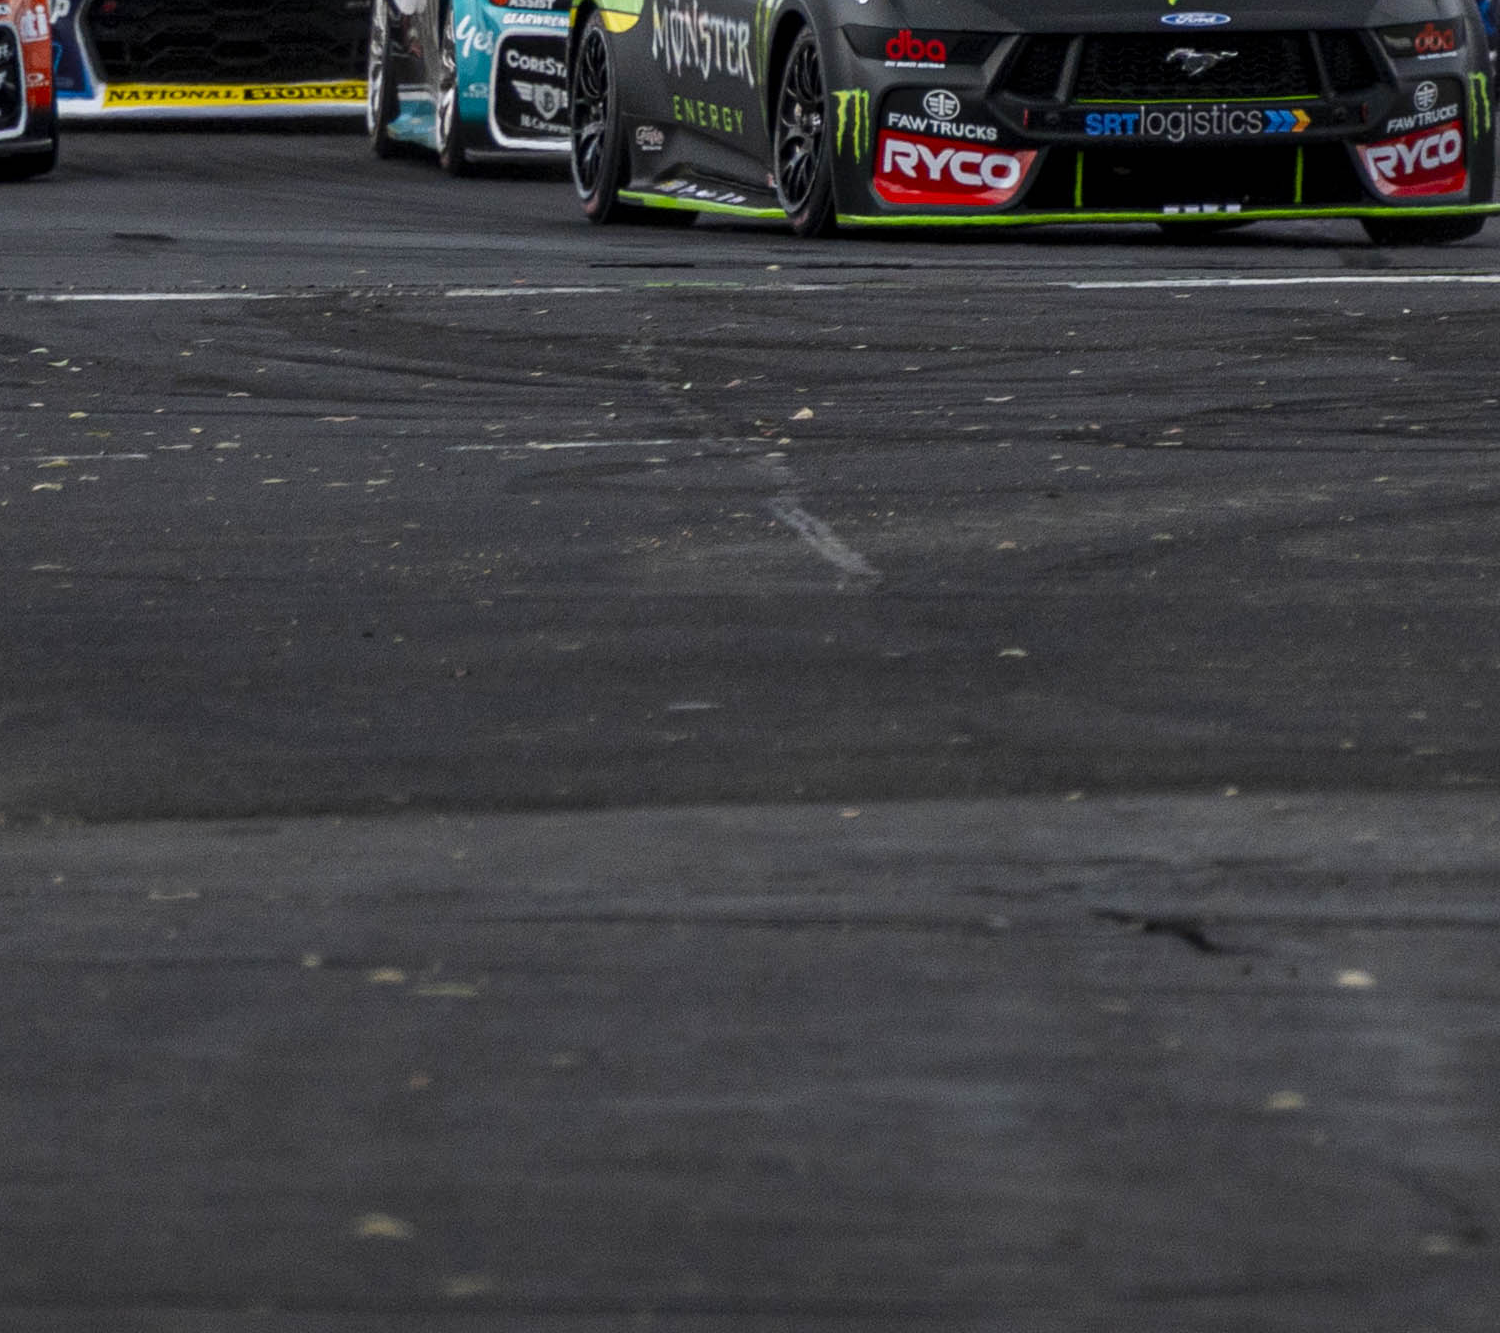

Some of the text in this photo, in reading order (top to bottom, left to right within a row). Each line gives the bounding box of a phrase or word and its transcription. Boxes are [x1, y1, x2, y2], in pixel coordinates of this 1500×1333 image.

[502, 11, 570, 27] GEARWREN
[885, 28, 947, 62] dba
[107, 85, 239, 103] NATIONAL
[672, 94, 746, 134] ENERGY
[888, 111, 998, 141] FAW TRUCKS
[1387, 102, 1459, 135] FAW TRUCKS
[883, 137, 1021, 189] RYCO
[1366, 129, 1463, 181] RYCO
